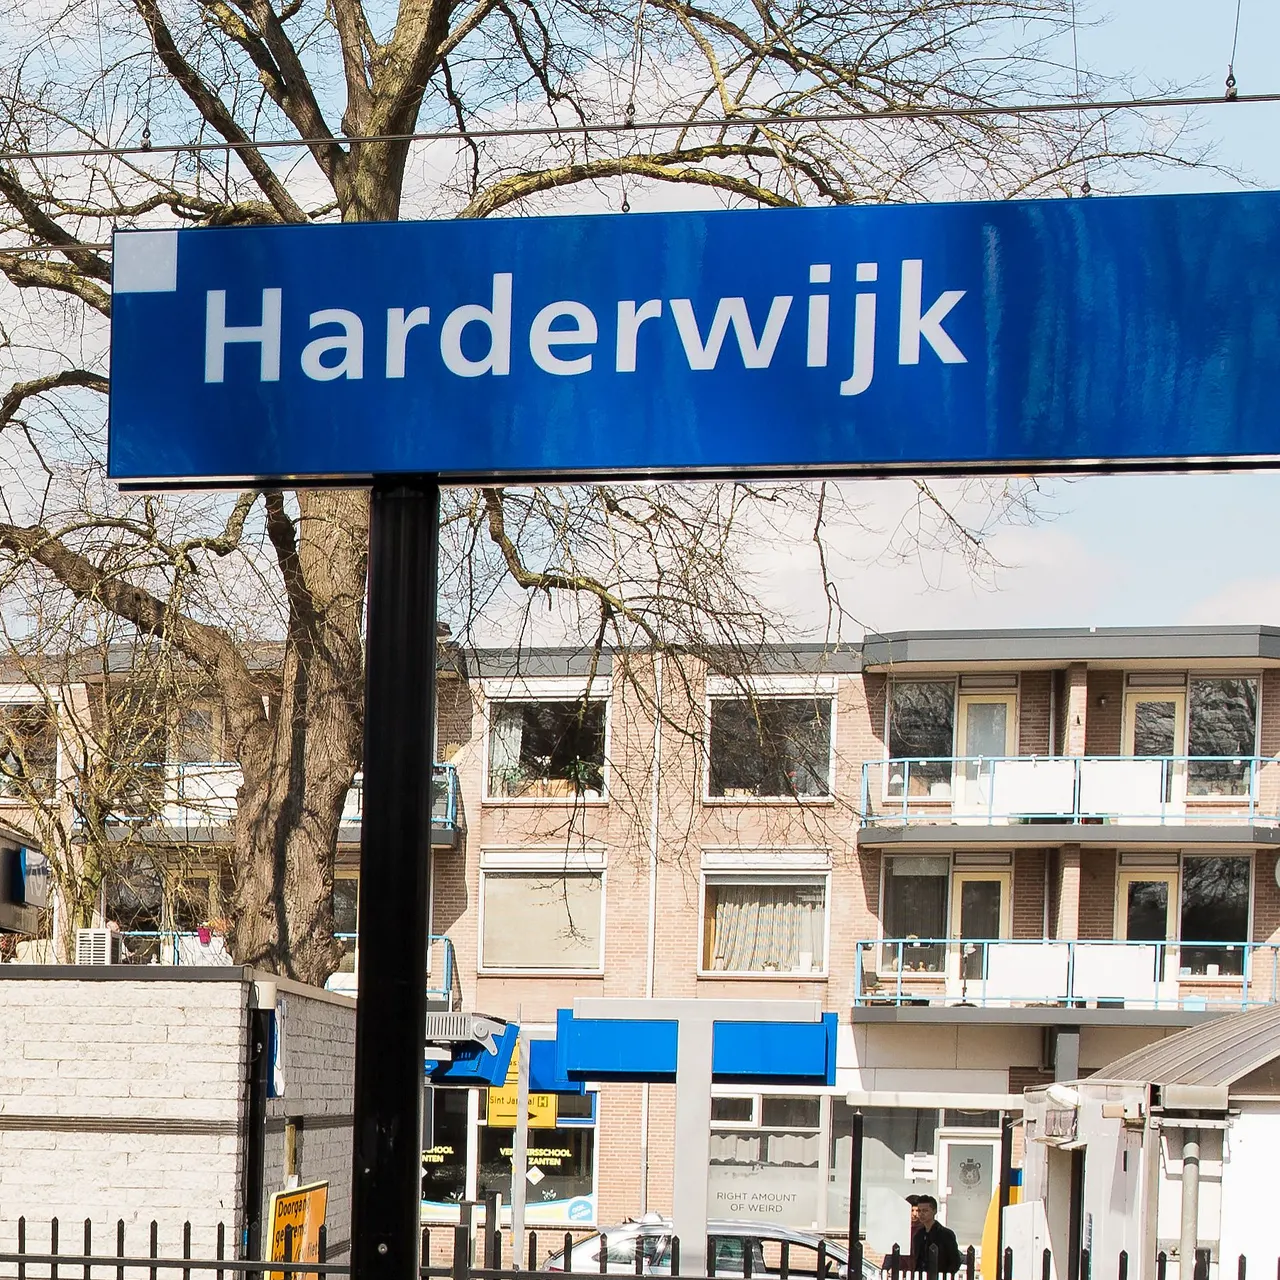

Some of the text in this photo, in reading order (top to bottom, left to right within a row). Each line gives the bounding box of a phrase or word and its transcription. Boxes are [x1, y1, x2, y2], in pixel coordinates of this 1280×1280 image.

[202, 257, 969, 398] Harderwijk
[489, 1096, 505, 1105] Sint
[528, 1158, 561, 1166] ZANTEN
[716, 1191, 796, 1203] RIGHT AMOUNT
[730, 1203, 784, 1213] OF WEIRD
